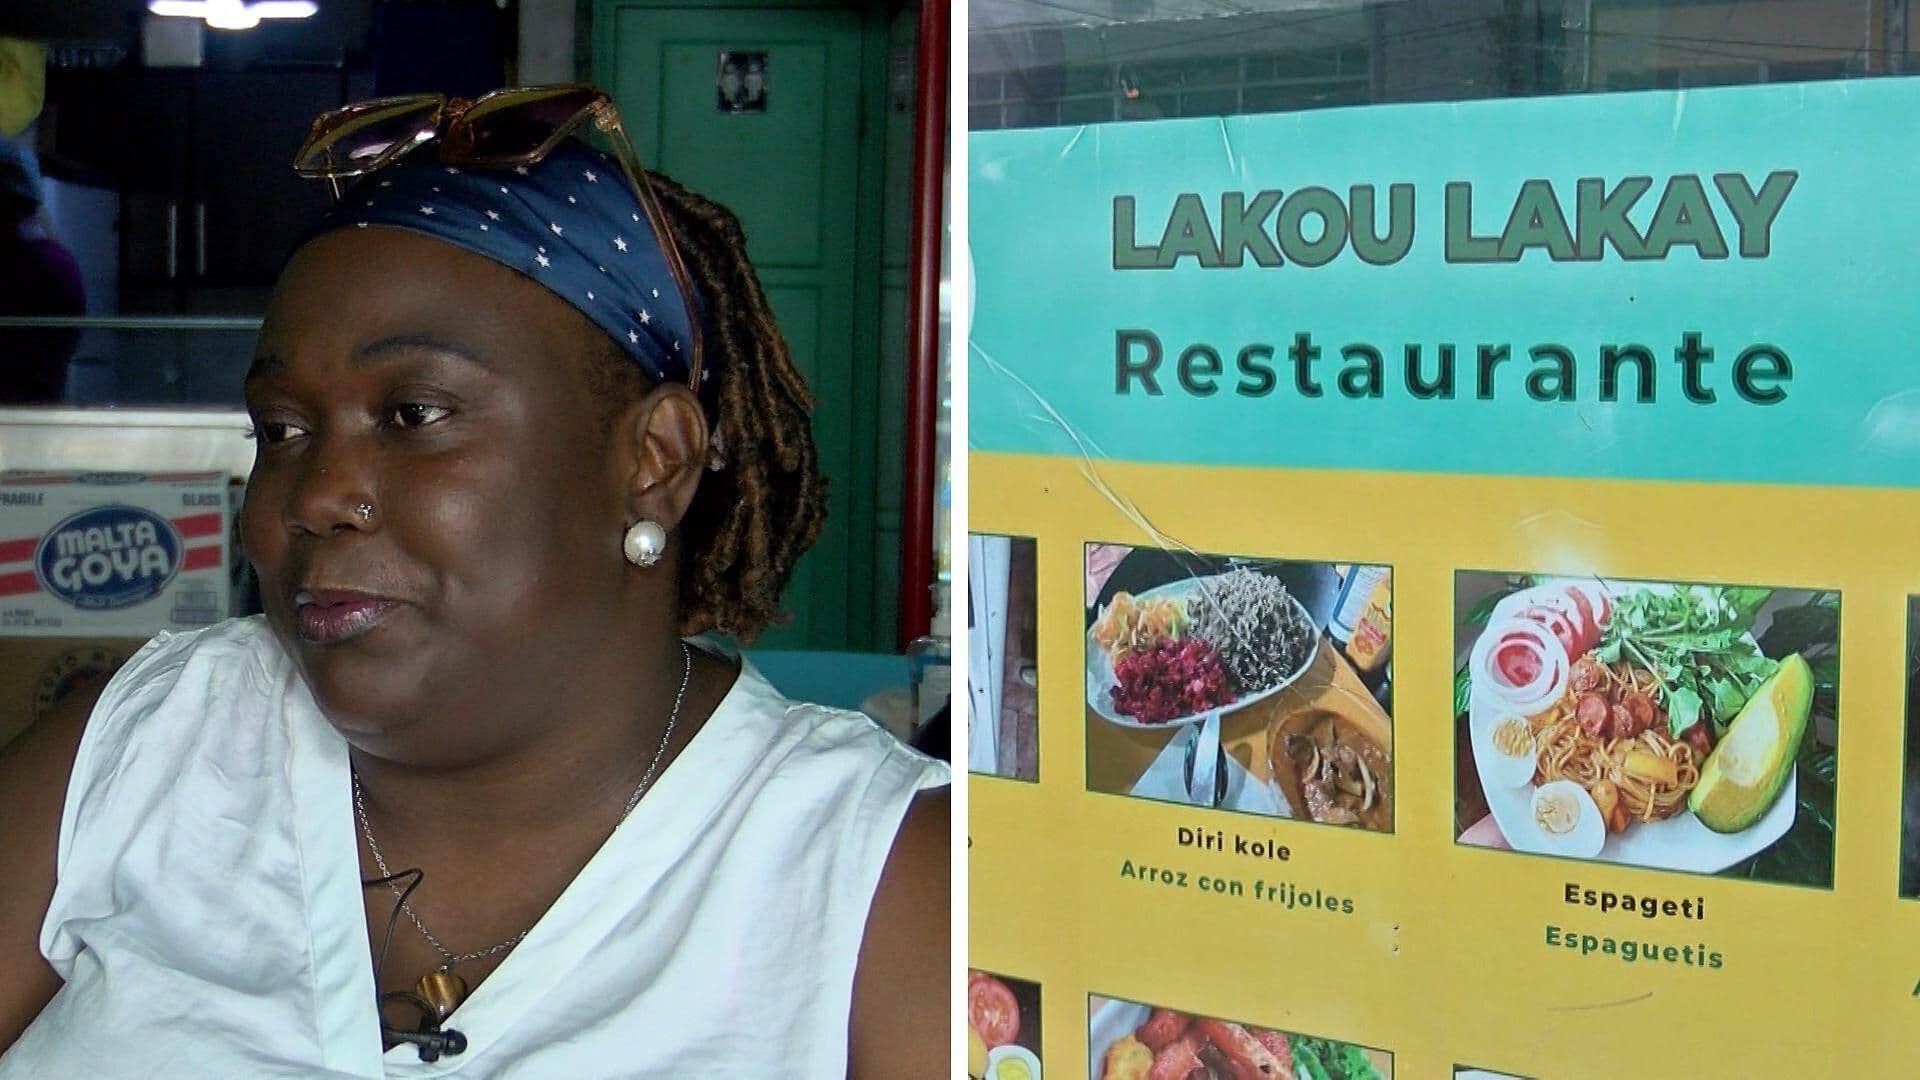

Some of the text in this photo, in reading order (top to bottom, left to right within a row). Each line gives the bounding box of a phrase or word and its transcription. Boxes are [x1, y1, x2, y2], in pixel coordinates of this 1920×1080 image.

[1112, 170, 1799, 270] LAKOU LAKAY
[1114, 328, 1795, 406] Restaurante
[57, 519, 157, 556] MALTA
[53, 545, 170, 592] GOYA
[1177, 826, 1291, 861] Diri kole
[1120, 859, 1355, 915] Arroz con frijoles
[1564, 883, 1706, 921] Espageti
[1545, 925, 1724, 969] Espaguetis
